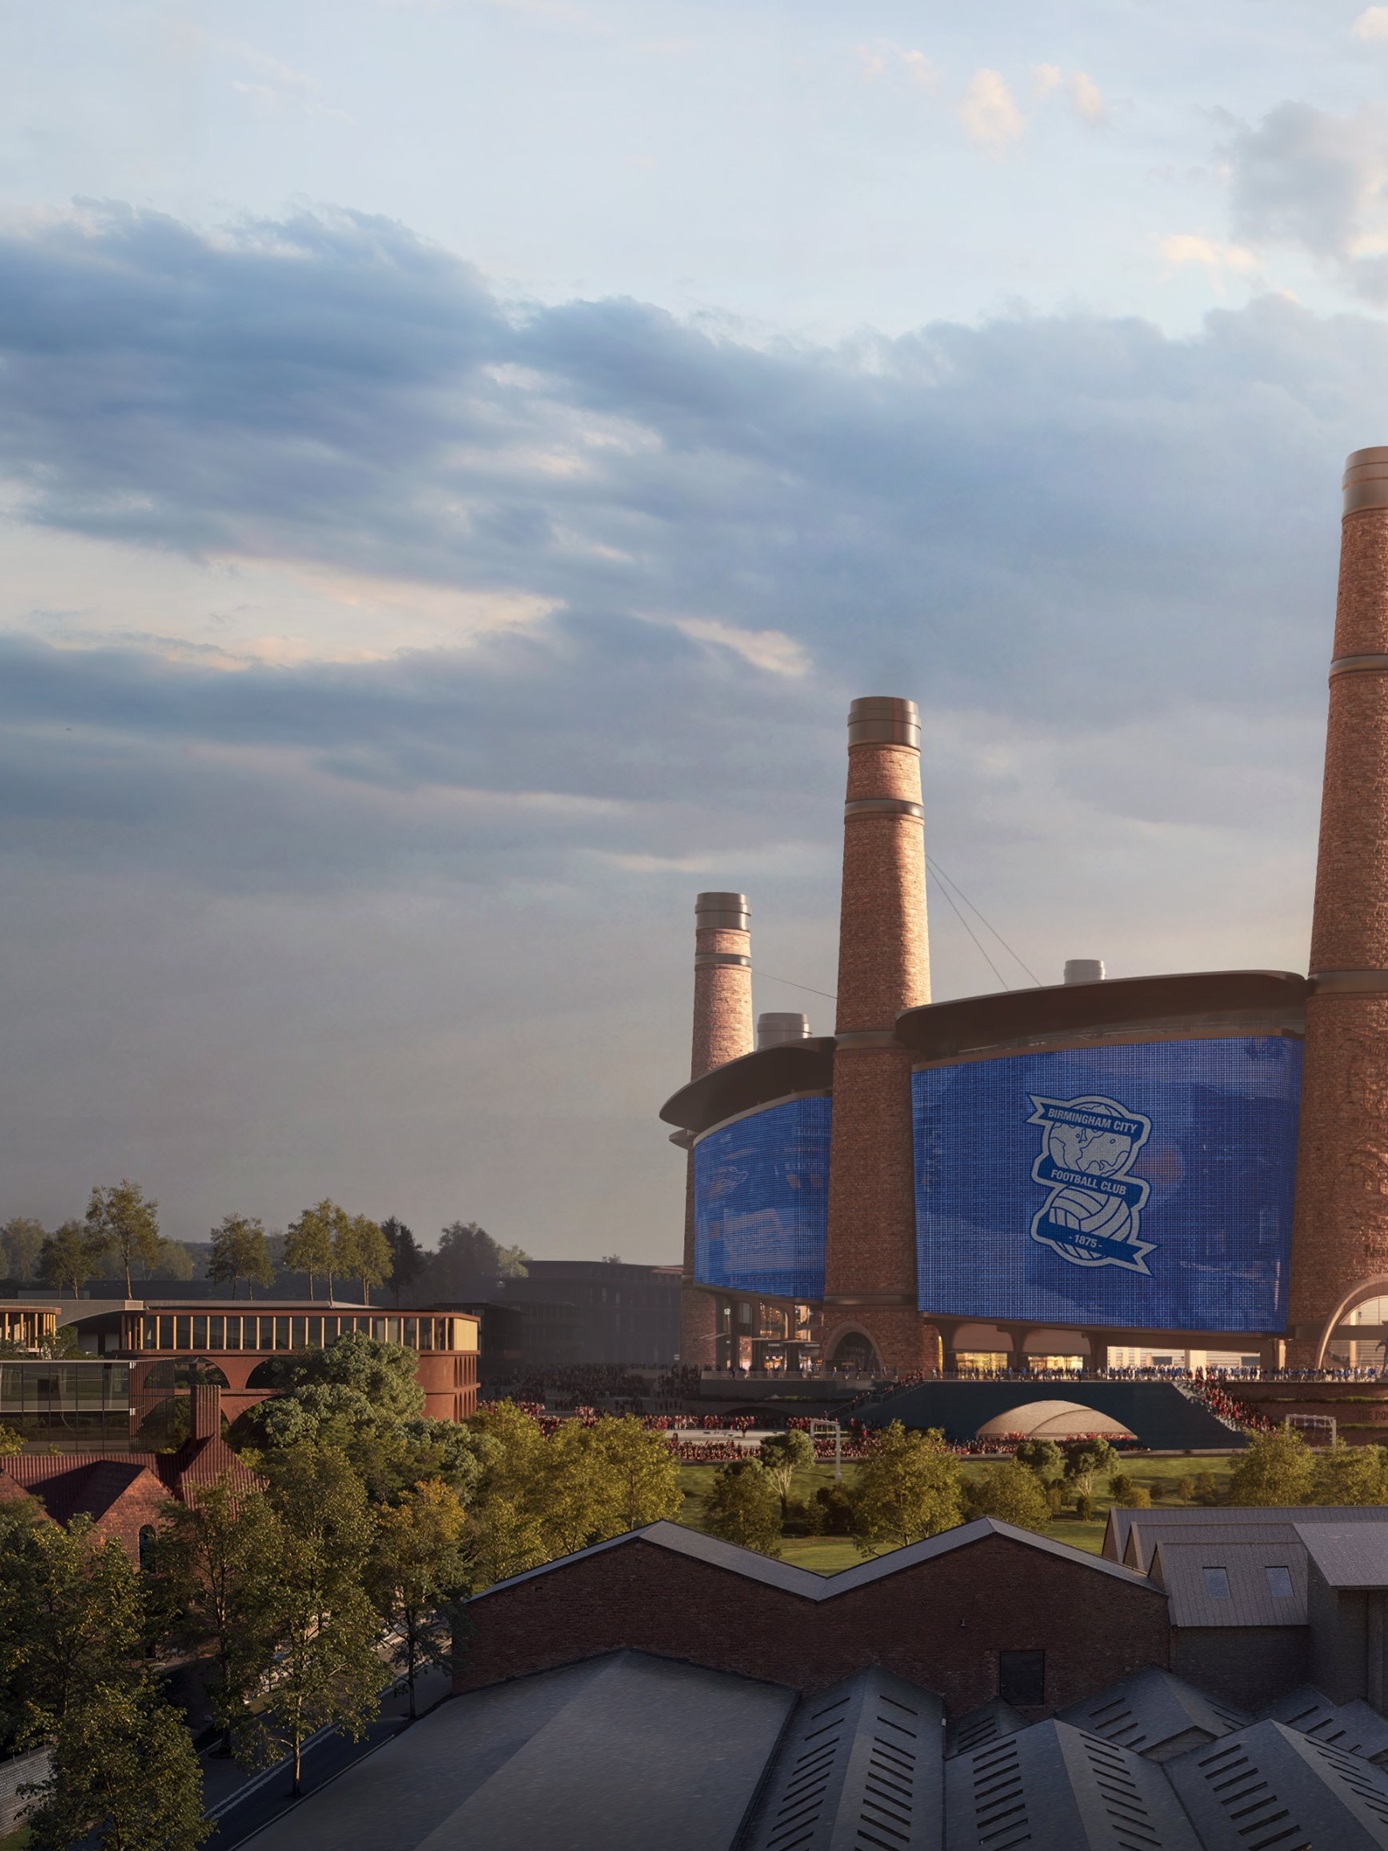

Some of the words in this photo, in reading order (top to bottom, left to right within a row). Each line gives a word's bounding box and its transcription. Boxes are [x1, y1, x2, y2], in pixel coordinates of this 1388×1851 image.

[1047, 1108, 1111, 1129] BIRMINGHAM
[1113, 1121, 1138, 1134] CITY
[1050, 1169, 1098, 1189] FOOTBALL
[1100, 1181, 1127, 1195] CLUB
